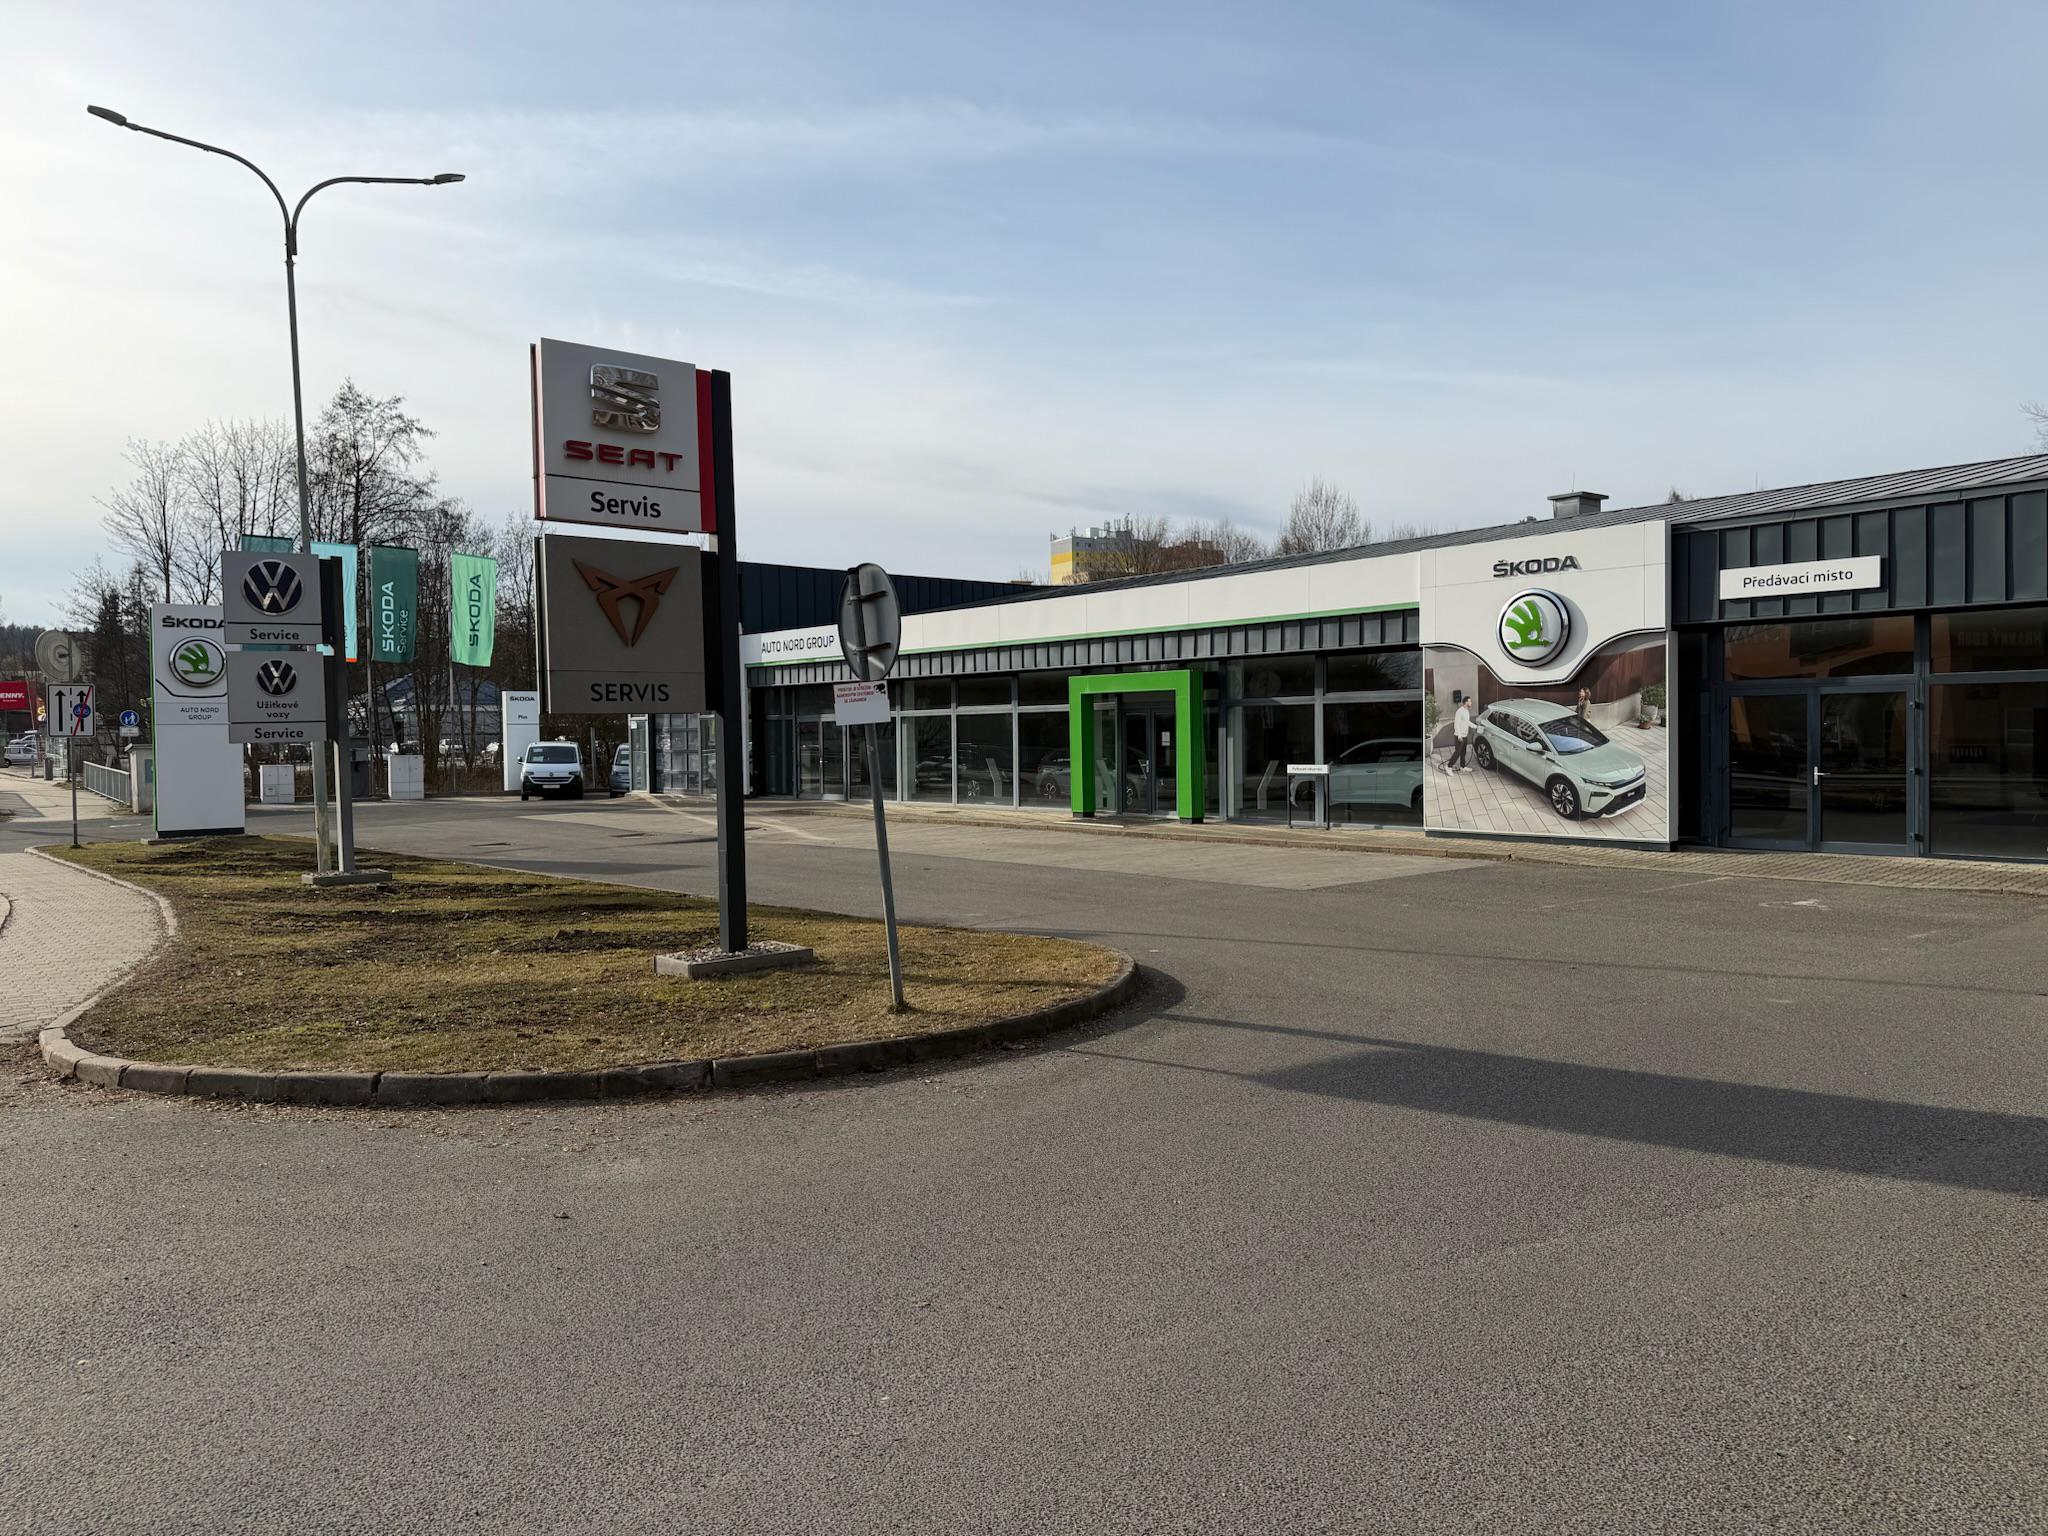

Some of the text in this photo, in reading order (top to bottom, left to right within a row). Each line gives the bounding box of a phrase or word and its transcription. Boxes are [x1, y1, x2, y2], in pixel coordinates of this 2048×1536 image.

[564, 439, 683, 471] SEAT
[590, 491, 661, 518] Servis
[1493, 555, 1582, 578] ŠKODA
[1743, 569, 1853, 588] Předávací místo
[249, 628, 300, 641] Service
[397, 609, 409, 653] Service
[761, 635, 835, 653] AUTO NORD GROUP
[590, 683, 670, 703] SERVIS
[256, 700, 299, 710] Užitkové
[266, 711, 290, 719] vozy
[254, 727, 304, 740] Service
